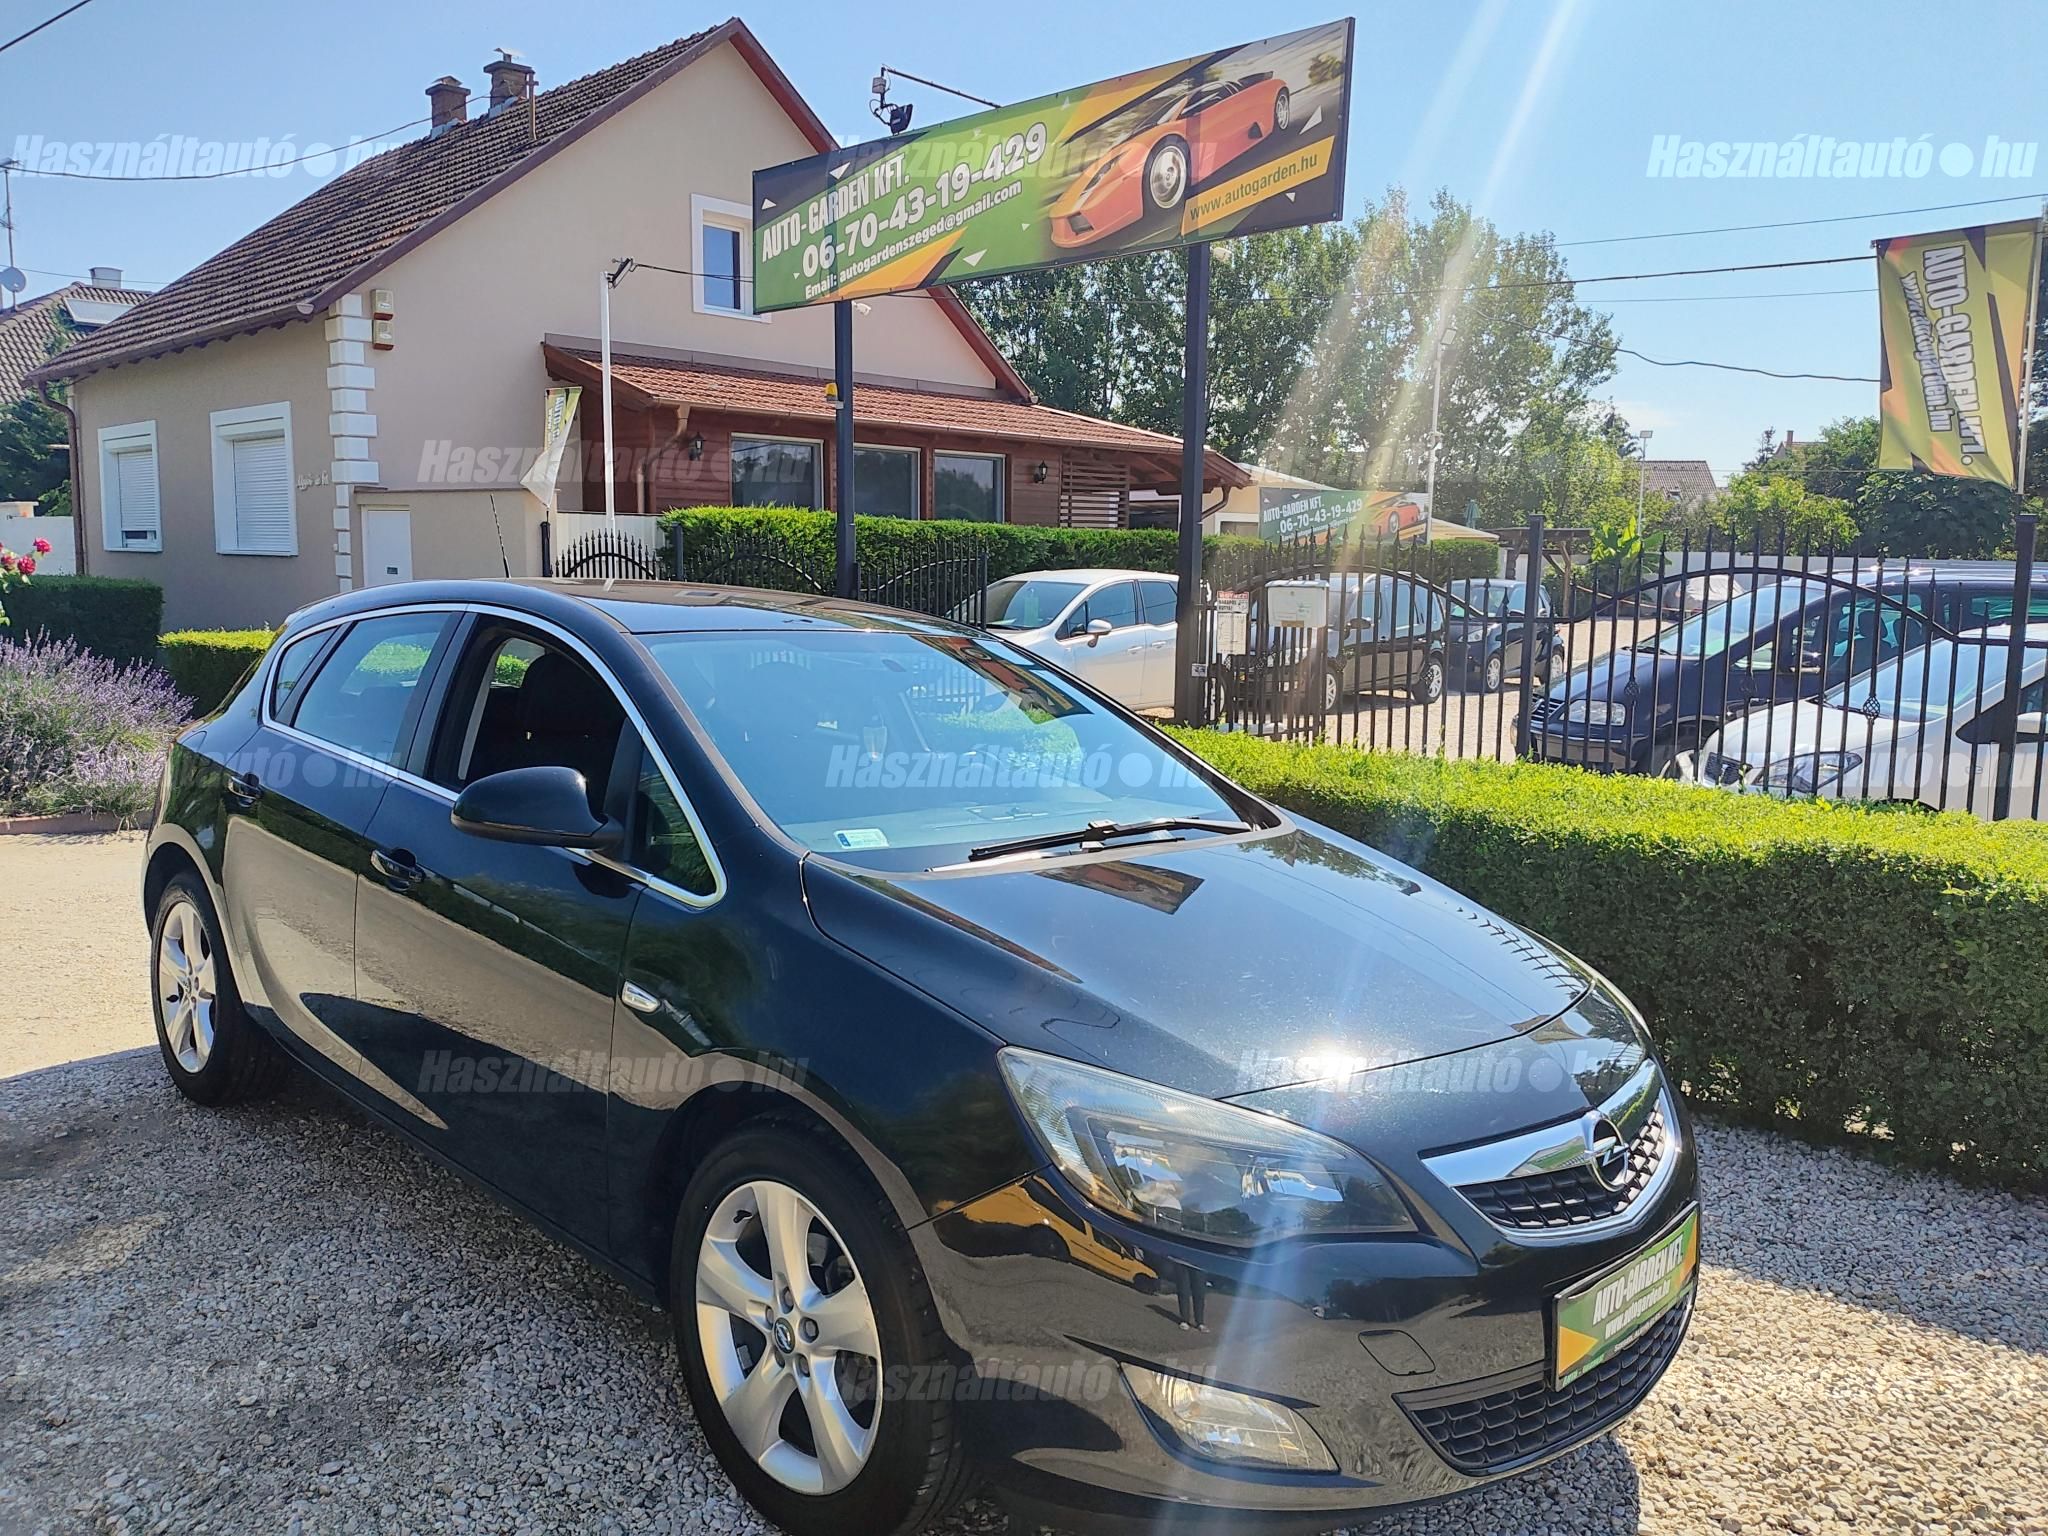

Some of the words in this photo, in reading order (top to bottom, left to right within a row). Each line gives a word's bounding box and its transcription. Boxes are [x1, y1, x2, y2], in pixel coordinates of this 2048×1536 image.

[762, 171, 870, 263] AUTO-GARDEN
[873, 153, 910, 201] KFT.
[802, 122, 1048, 278] 06-70-43-19-429
[1190, 153, 1317, 220] www.autogarden.hu
[805, 273, 839, 300] Email:
[839, 180, 1022, 286] autogardenszeged@gmail.com
[1923, 244, 1981, 413] AUTO-GARDEN
[1263, 499, 1309, 523] AUTO-GARDEN
[1309, 495, 1325, 510] KFT.
[1279, 498, 1363, 534] 06-70-43-19-429
[1592, 1247, 1666, 1326] AUTO-GARDEN
